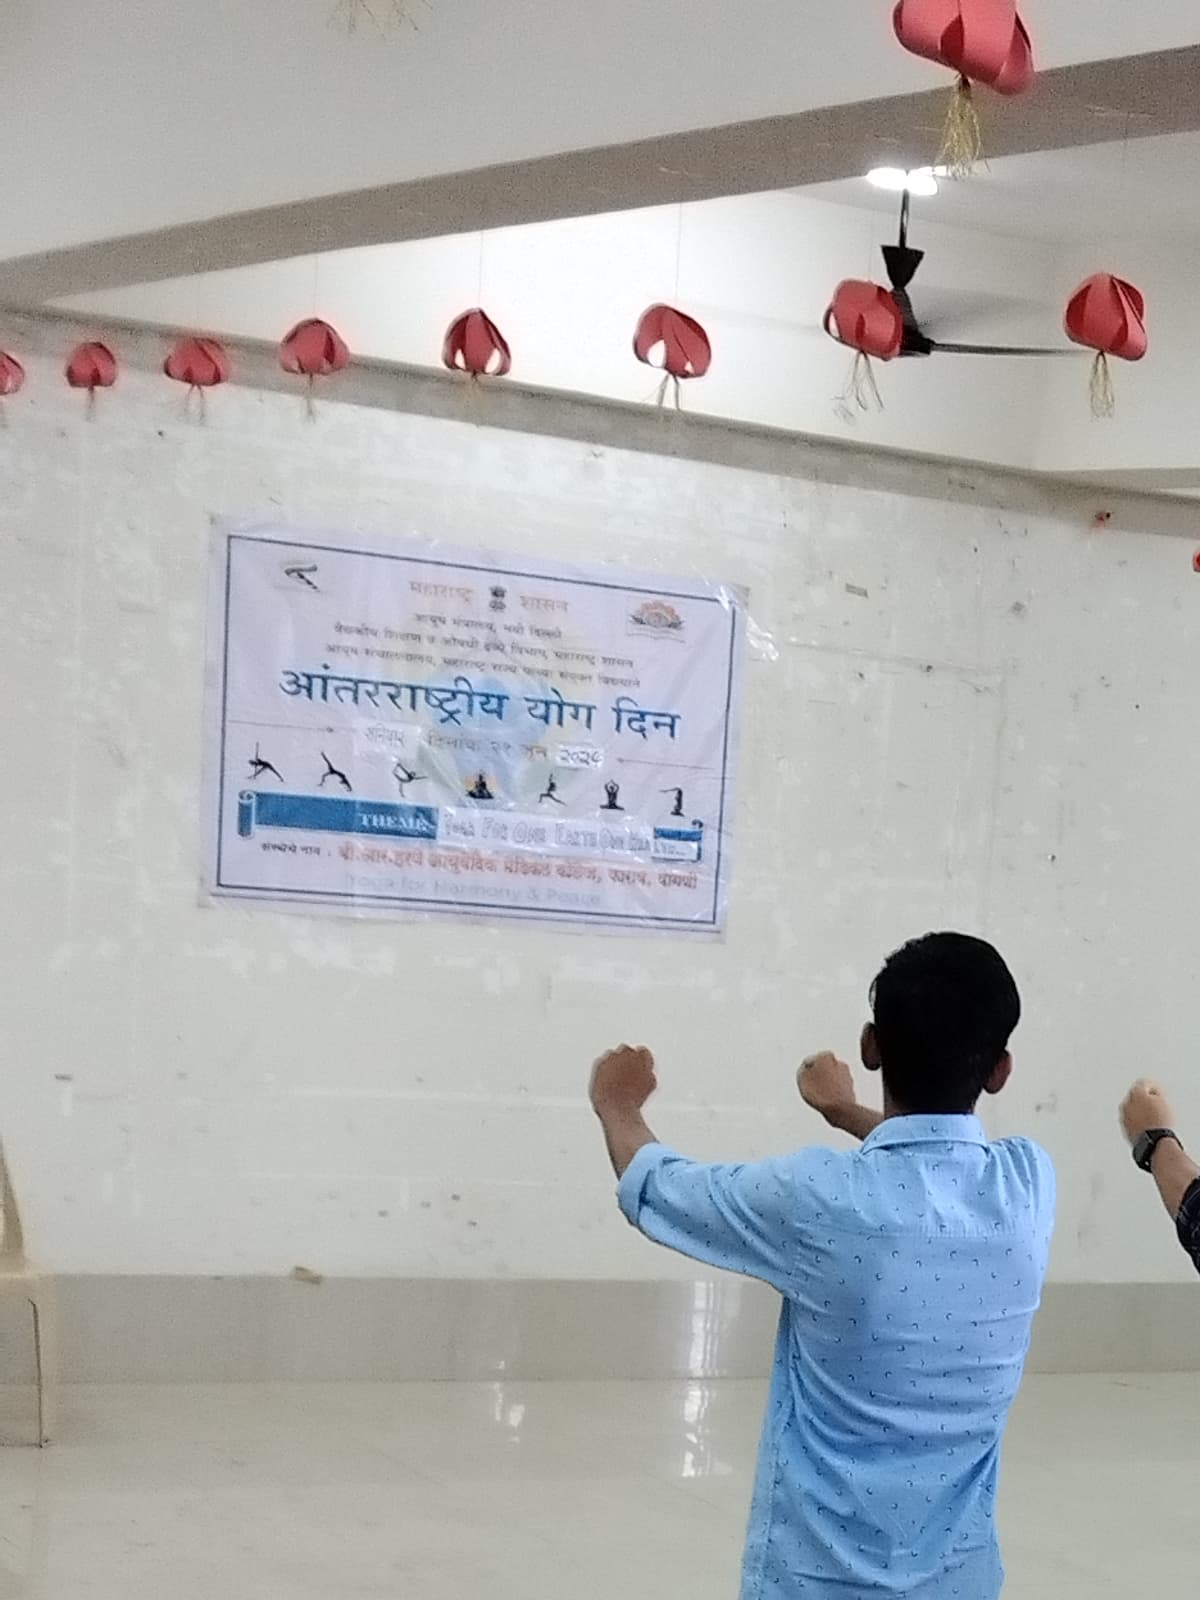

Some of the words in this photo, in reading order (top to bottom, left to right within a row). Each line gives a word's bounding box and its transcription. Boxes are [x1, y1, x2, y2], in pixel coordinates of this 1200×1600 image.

[279, 662, 508, 726] आंतरराष्ट्रीय
[525, 687, 597, 730] योग
[611, 696, 681, 739] दिन
